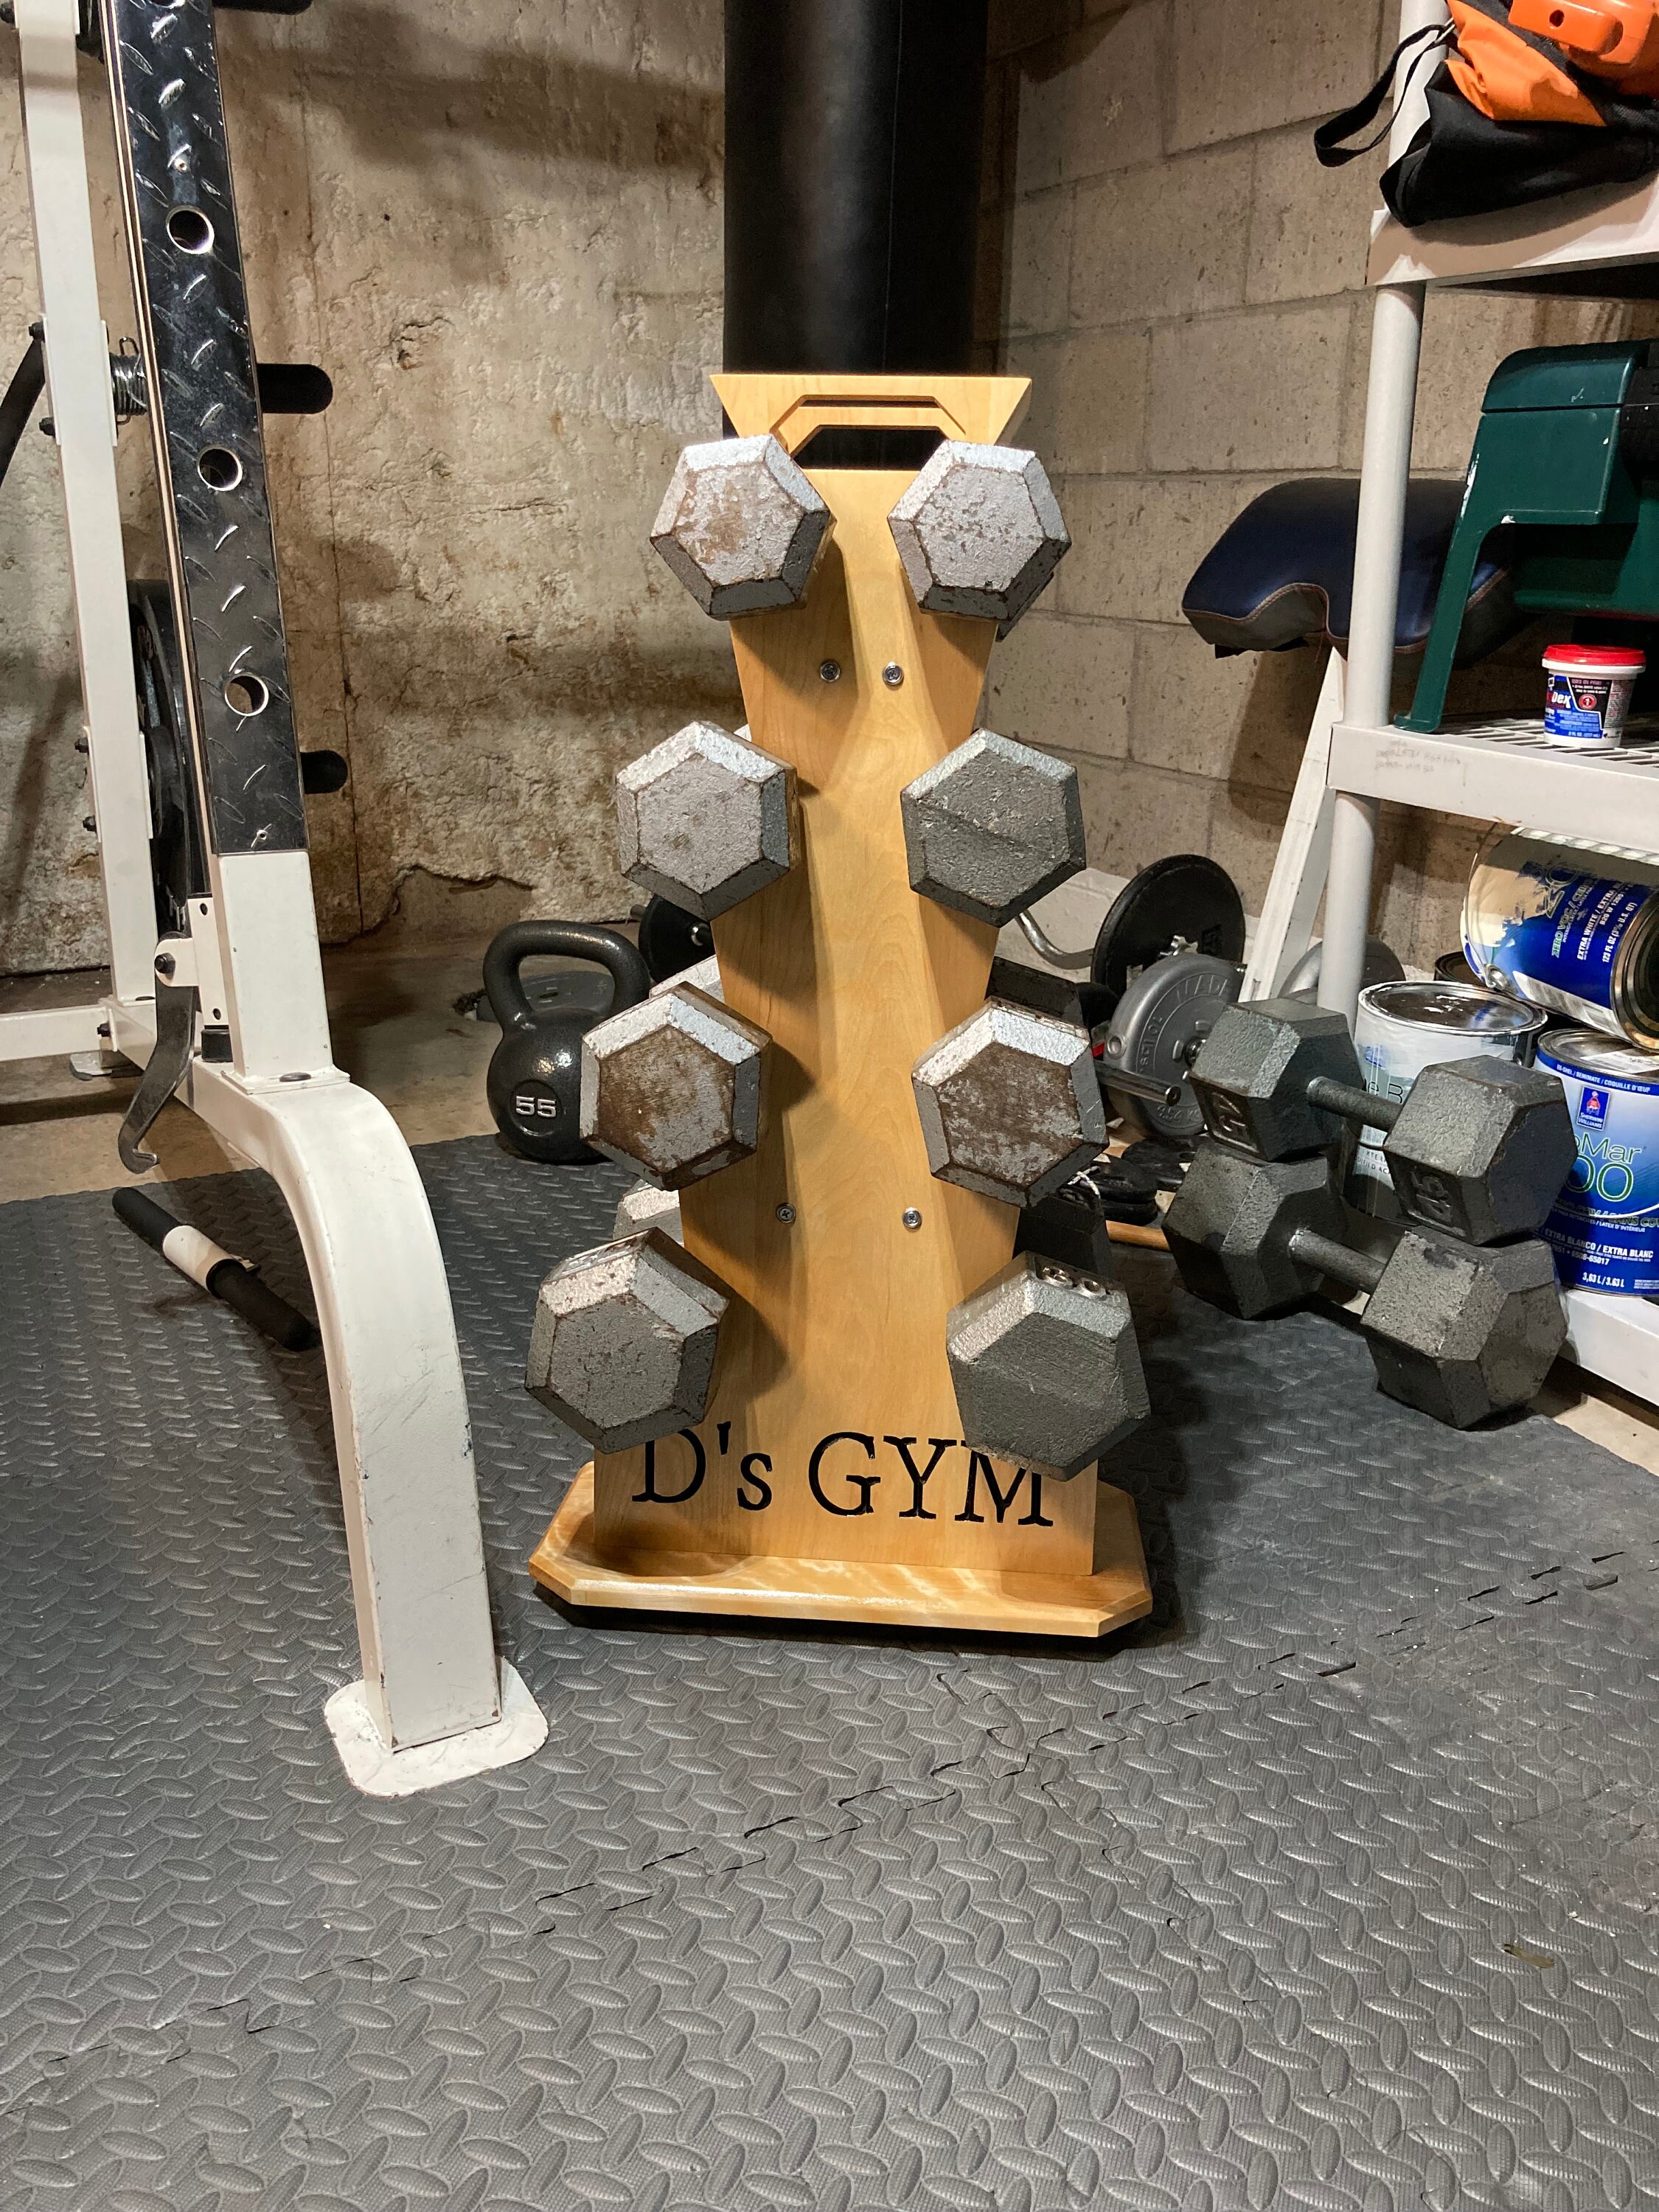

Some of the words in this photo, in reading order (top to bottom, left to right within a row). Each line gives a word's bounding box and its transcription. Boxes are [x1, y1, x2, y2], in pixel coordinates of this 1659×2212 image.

[1557, 907, 1573, 931] VOC
[1576, 936, 1589, 961] EXTRA
[1583, 914, 1599, 936] WHITE
[1597, 889, 1616, 909] EXTRA
[1551, 931, 1564, 959] ZERO
[1604, 944, 1613, 953] FL
[1607, 935, 1616, 945] OZ
[1601, 951, 1610, 963] 123
[1576, 1071, 1601, 1084] SEMIMATE
[1604, 1079, 1631, 1090] COQUILLE
[515, 1095, 557, 1118] 55
[1599, 1221, 1614, 1229] LATEX
[1567, 1236, 1596, 1251] BLANCO
[1602, 1245, 1628, 1256] EXTRA
[1629, 1249, 1654, 1259] BLANC
[631, 1420, 774, 1511] D's
[809, 1431, 1054, 1527] GYM
